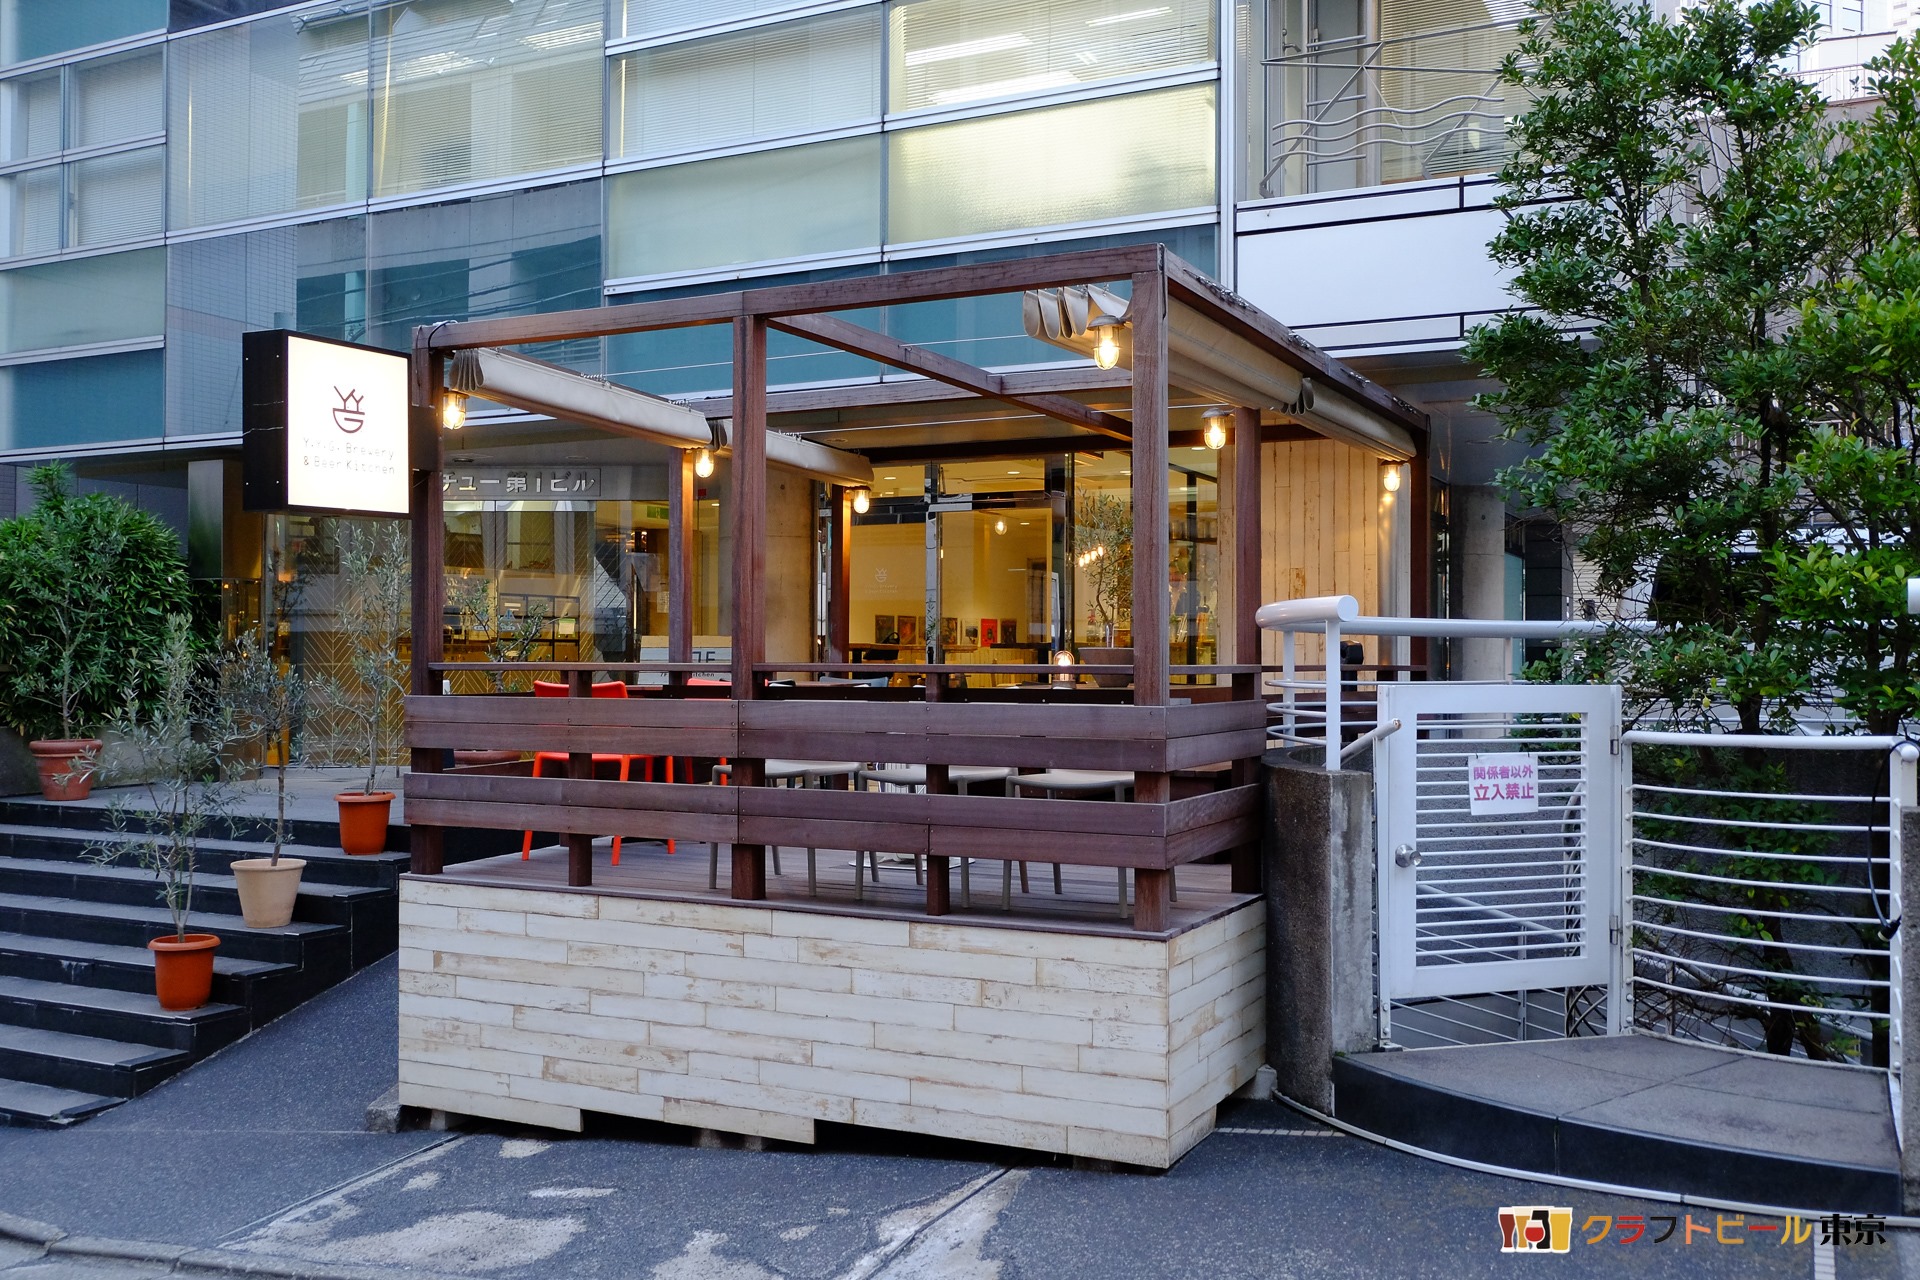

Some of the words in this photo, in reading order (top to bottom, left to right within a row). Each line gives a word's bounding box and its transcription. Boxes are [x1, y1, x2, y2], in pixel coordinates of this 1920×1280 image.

[345, 442, 394, 461] Brewery
[303, 455, 310, 466] &
[314, 456, 342, 468] Beer
[346, 459, 395, 475] Kitchen
[1473, 765, 1533, 780] 関係者以外
[1473, 783, 1534, 801] 立入禁止
